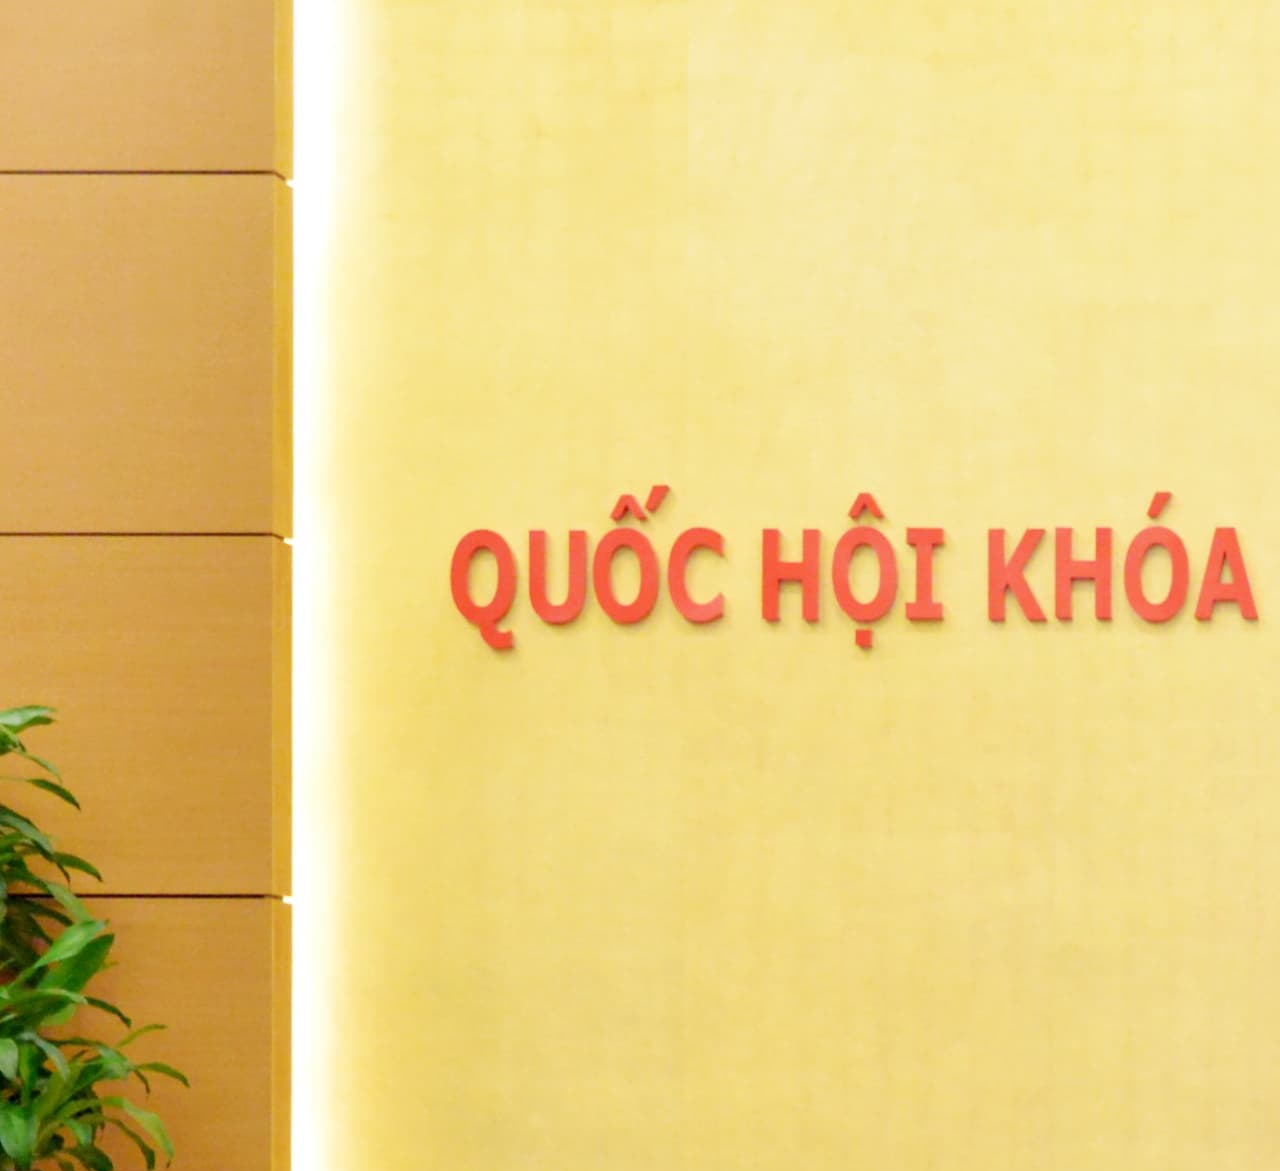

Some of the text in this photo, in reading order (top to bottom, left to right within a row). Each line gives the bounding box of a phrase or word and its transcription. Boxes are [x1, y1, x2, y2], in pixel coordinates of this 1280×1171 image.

[450, 484, 724, 651] QUỐC
[760, 492, 945, 650] HỘI
[987, 491, 1258, 624] KHÓA
